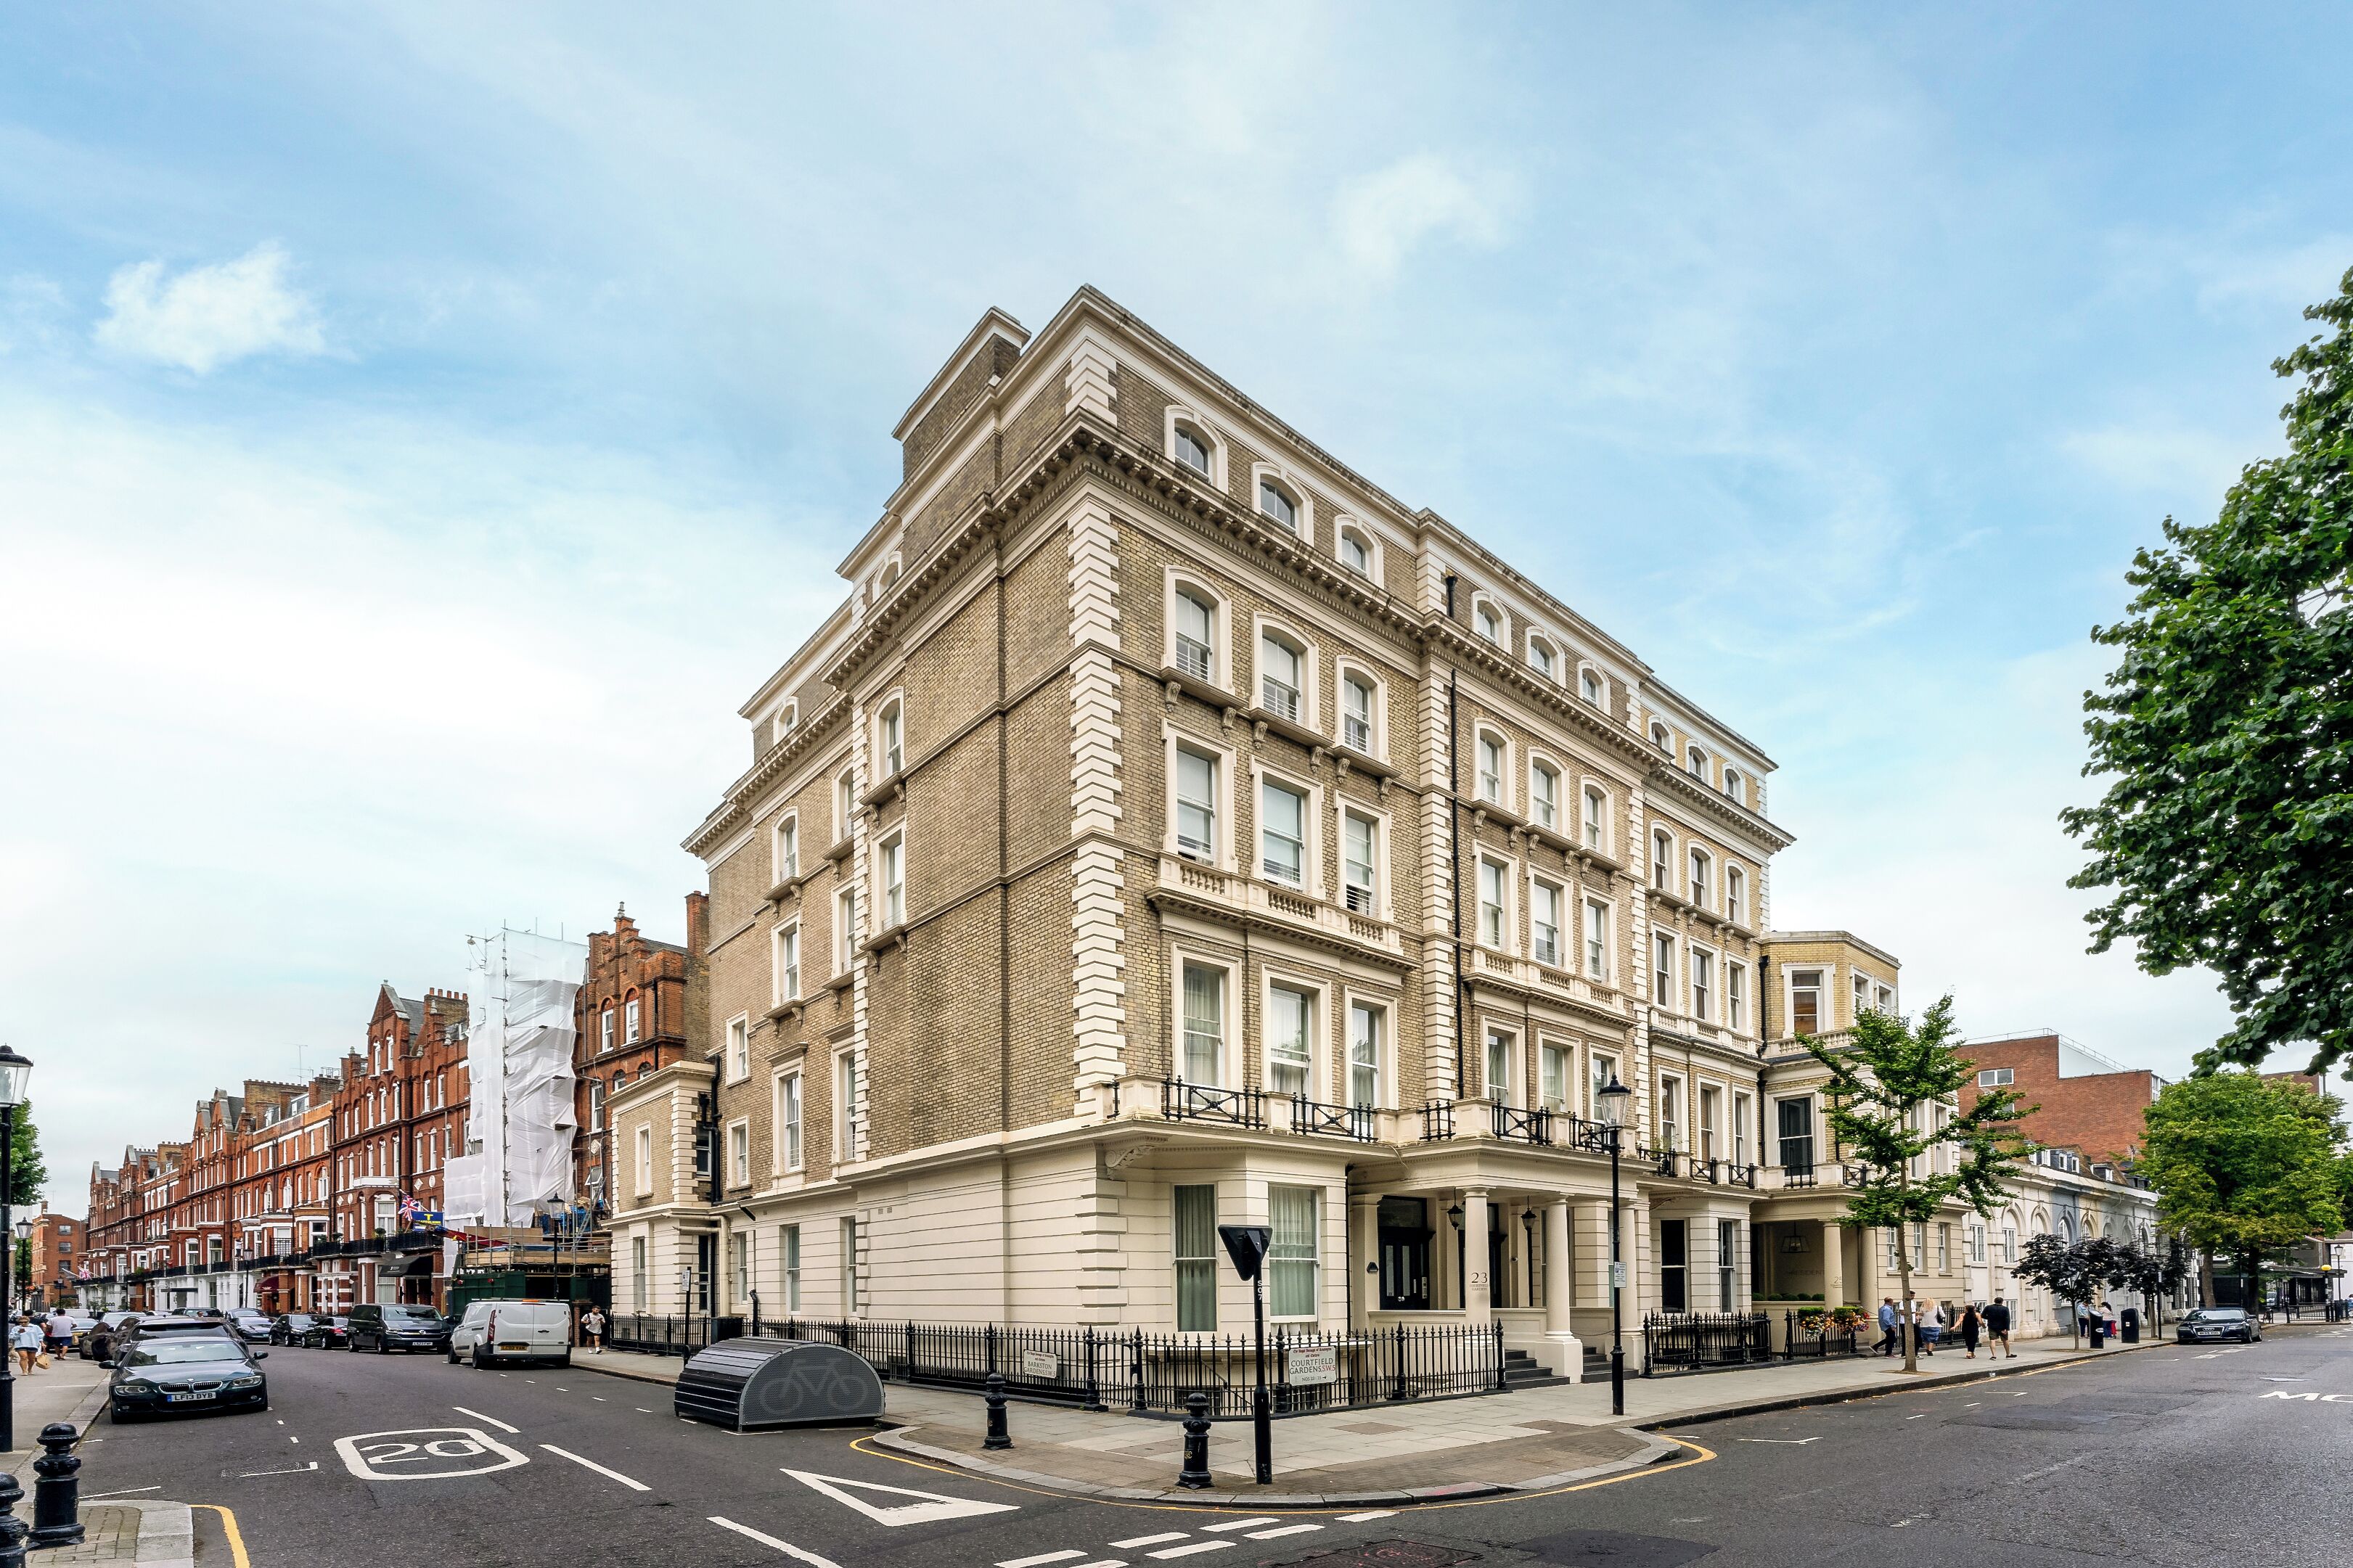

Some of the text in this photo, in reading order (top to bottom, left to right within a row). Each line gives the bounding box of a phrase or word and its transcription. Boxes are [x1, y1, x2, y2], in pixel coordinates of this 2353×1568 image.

[1471, 1272, 1487, 1284] 23
[1028, 1361, 1052, 1370] BARKSTON
[1290, 1358, 1333, 1367] COURTFIELD
[359, 1440, 487, 1464] 20
